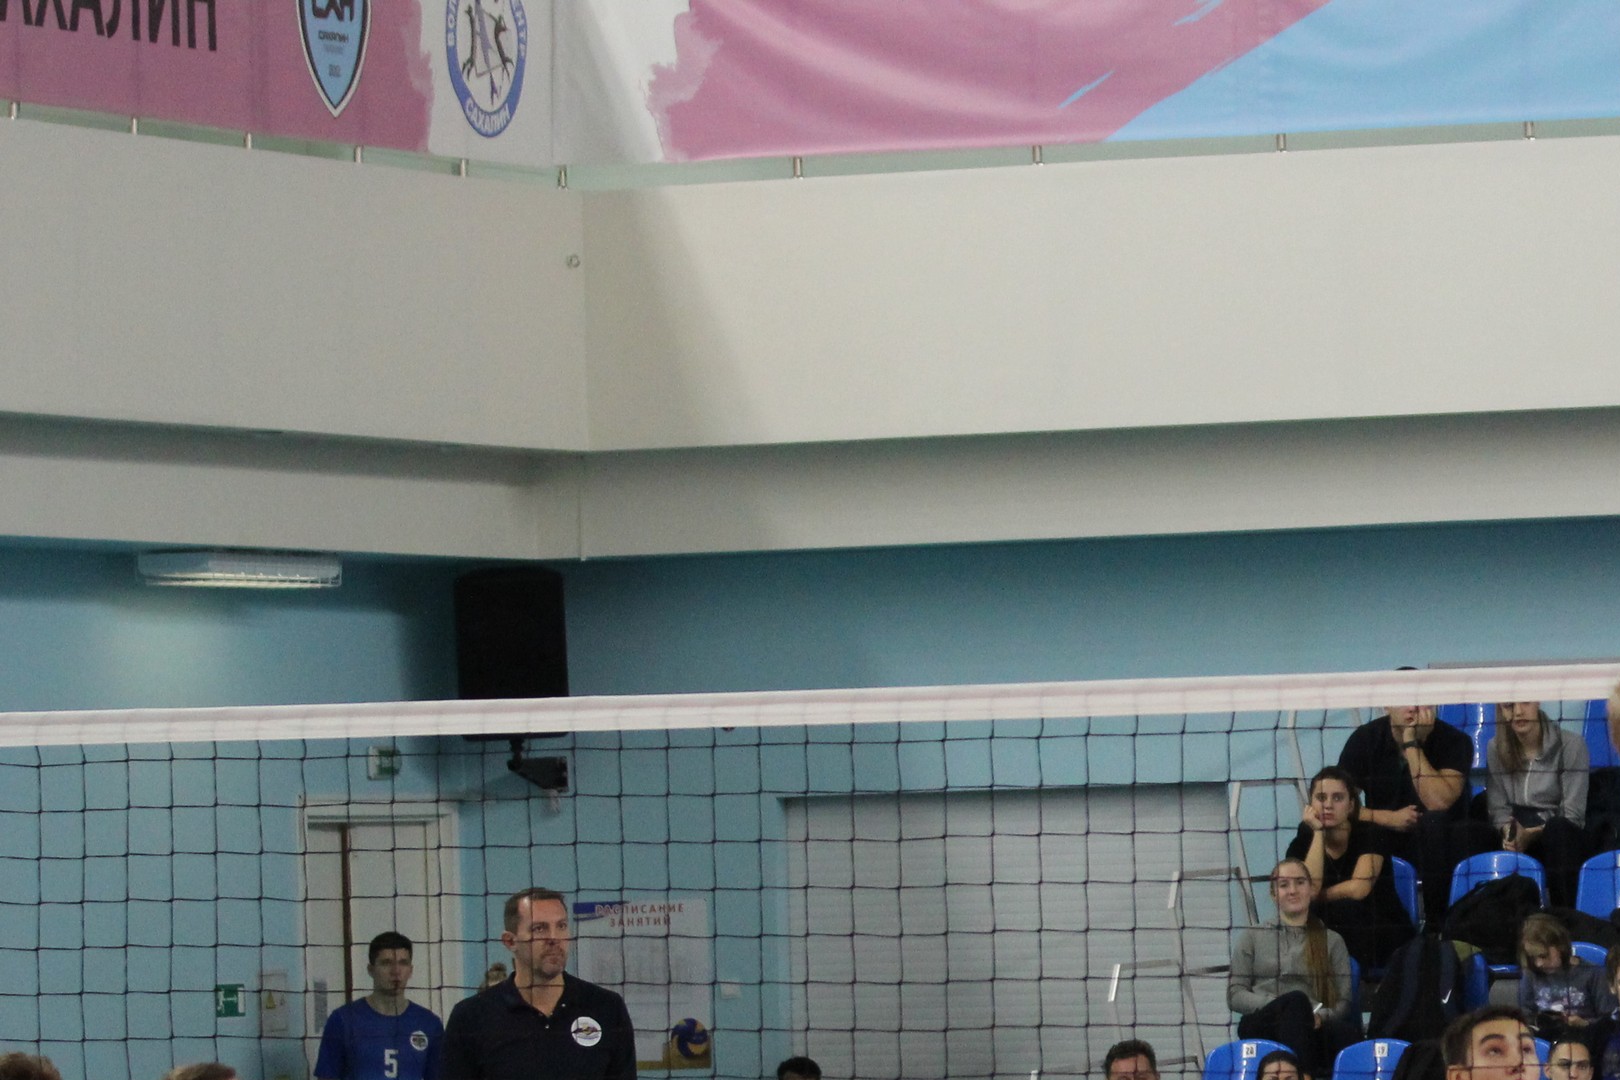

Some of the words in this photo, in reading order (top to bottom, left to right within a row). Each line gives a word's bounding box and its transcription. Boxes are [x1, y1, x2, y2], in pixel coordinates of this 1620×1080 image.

[465, 97, 511, 132] САХАЛИН
[595, 903, 684, 916] РАСПИСАНИЕ
[384, 1049, 398, 1078] 5
